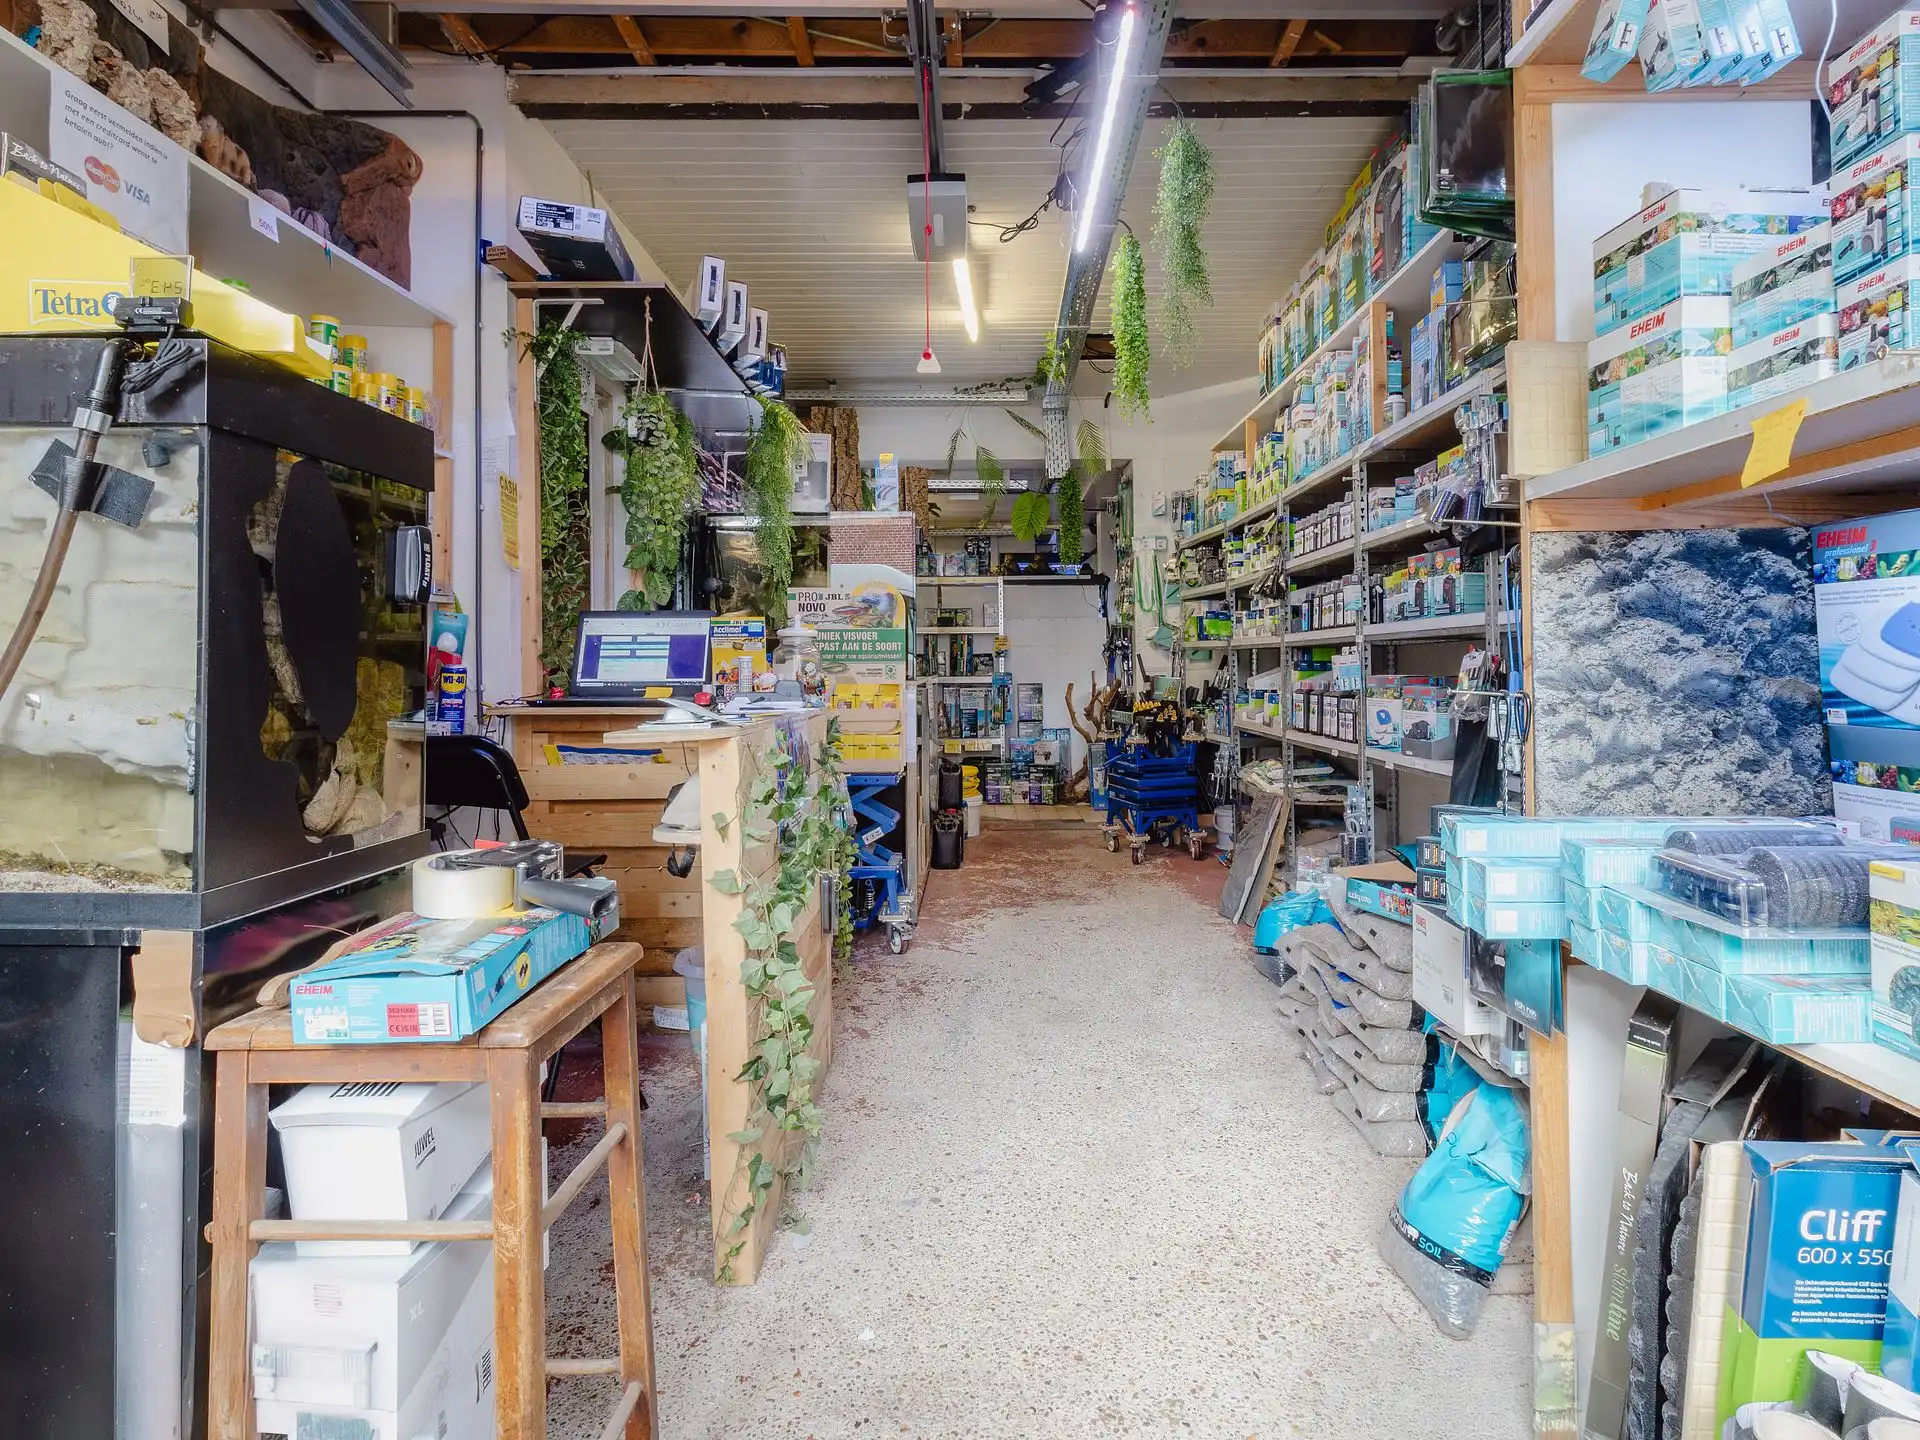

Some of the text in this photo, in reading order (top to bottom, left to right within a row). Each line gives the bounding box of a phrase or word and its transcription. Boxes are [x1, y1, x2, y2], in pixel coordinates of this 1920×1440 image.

[1848, 34, 1878, 62] EHEIM
[64, 90, 88, 110] Graag
[89, 105, 107, 121] eerst
[108, 117, 143, 144] vermelden
[144, 138, 163, 156] indien
[64, 116, 92, 138] betalen
[65, 103, 80, 118] met
[81, 113, 95, 127] een
[96, 123, 131, 148] creditcard
[132, 144, 151, 161] wenst
[10, 142, 81, 190] Back to Nature
[1852, 154, 1883, 179] EHEIM
[124, 180, 151, 208] VISA
[1642, 202, 1666, 223] EHEIM
[1777, 236, 1807, 256] EHEIM
[1857, 273, 1885, 293] EHEIM
[35, 288, 100, 316] Tetra
[1630, 312, 1666, 339] EHEIM
[1773, 328, 1800, 346] EHEIM
[500, 476, 517, 497] CASH
[1816, 526, 1868, 548] EHEIM
[1824, 543, 1869, 558] professional
[798, 592, 818, 602] PRO
[798, 602, 826, 613] NOVO
[825, 593, 843, 601] JBL
[842, 642, 859, 651] AAN
[862, 642, 873, 651] DE
[875, 642, 903, 651] SOORT
[843, 631, 878, 641] VISVOER
[442, 674, 465, 685] WD-40
[295, 985, 333, 995] EHEIM
[414, 1127, 435, 1160] JUWEL
[1622, 1166, 1639, 1200] Back
[1617, 1212, 1636, 1252] Nature
[1800, 1208, 1887, 1242] Cliff
[1418, 1236, 1441, 1259] SOIL
[1797, 1247, 1894, 1266] 600 x 550
[482, 1348, 492, 1394] JUWEL
